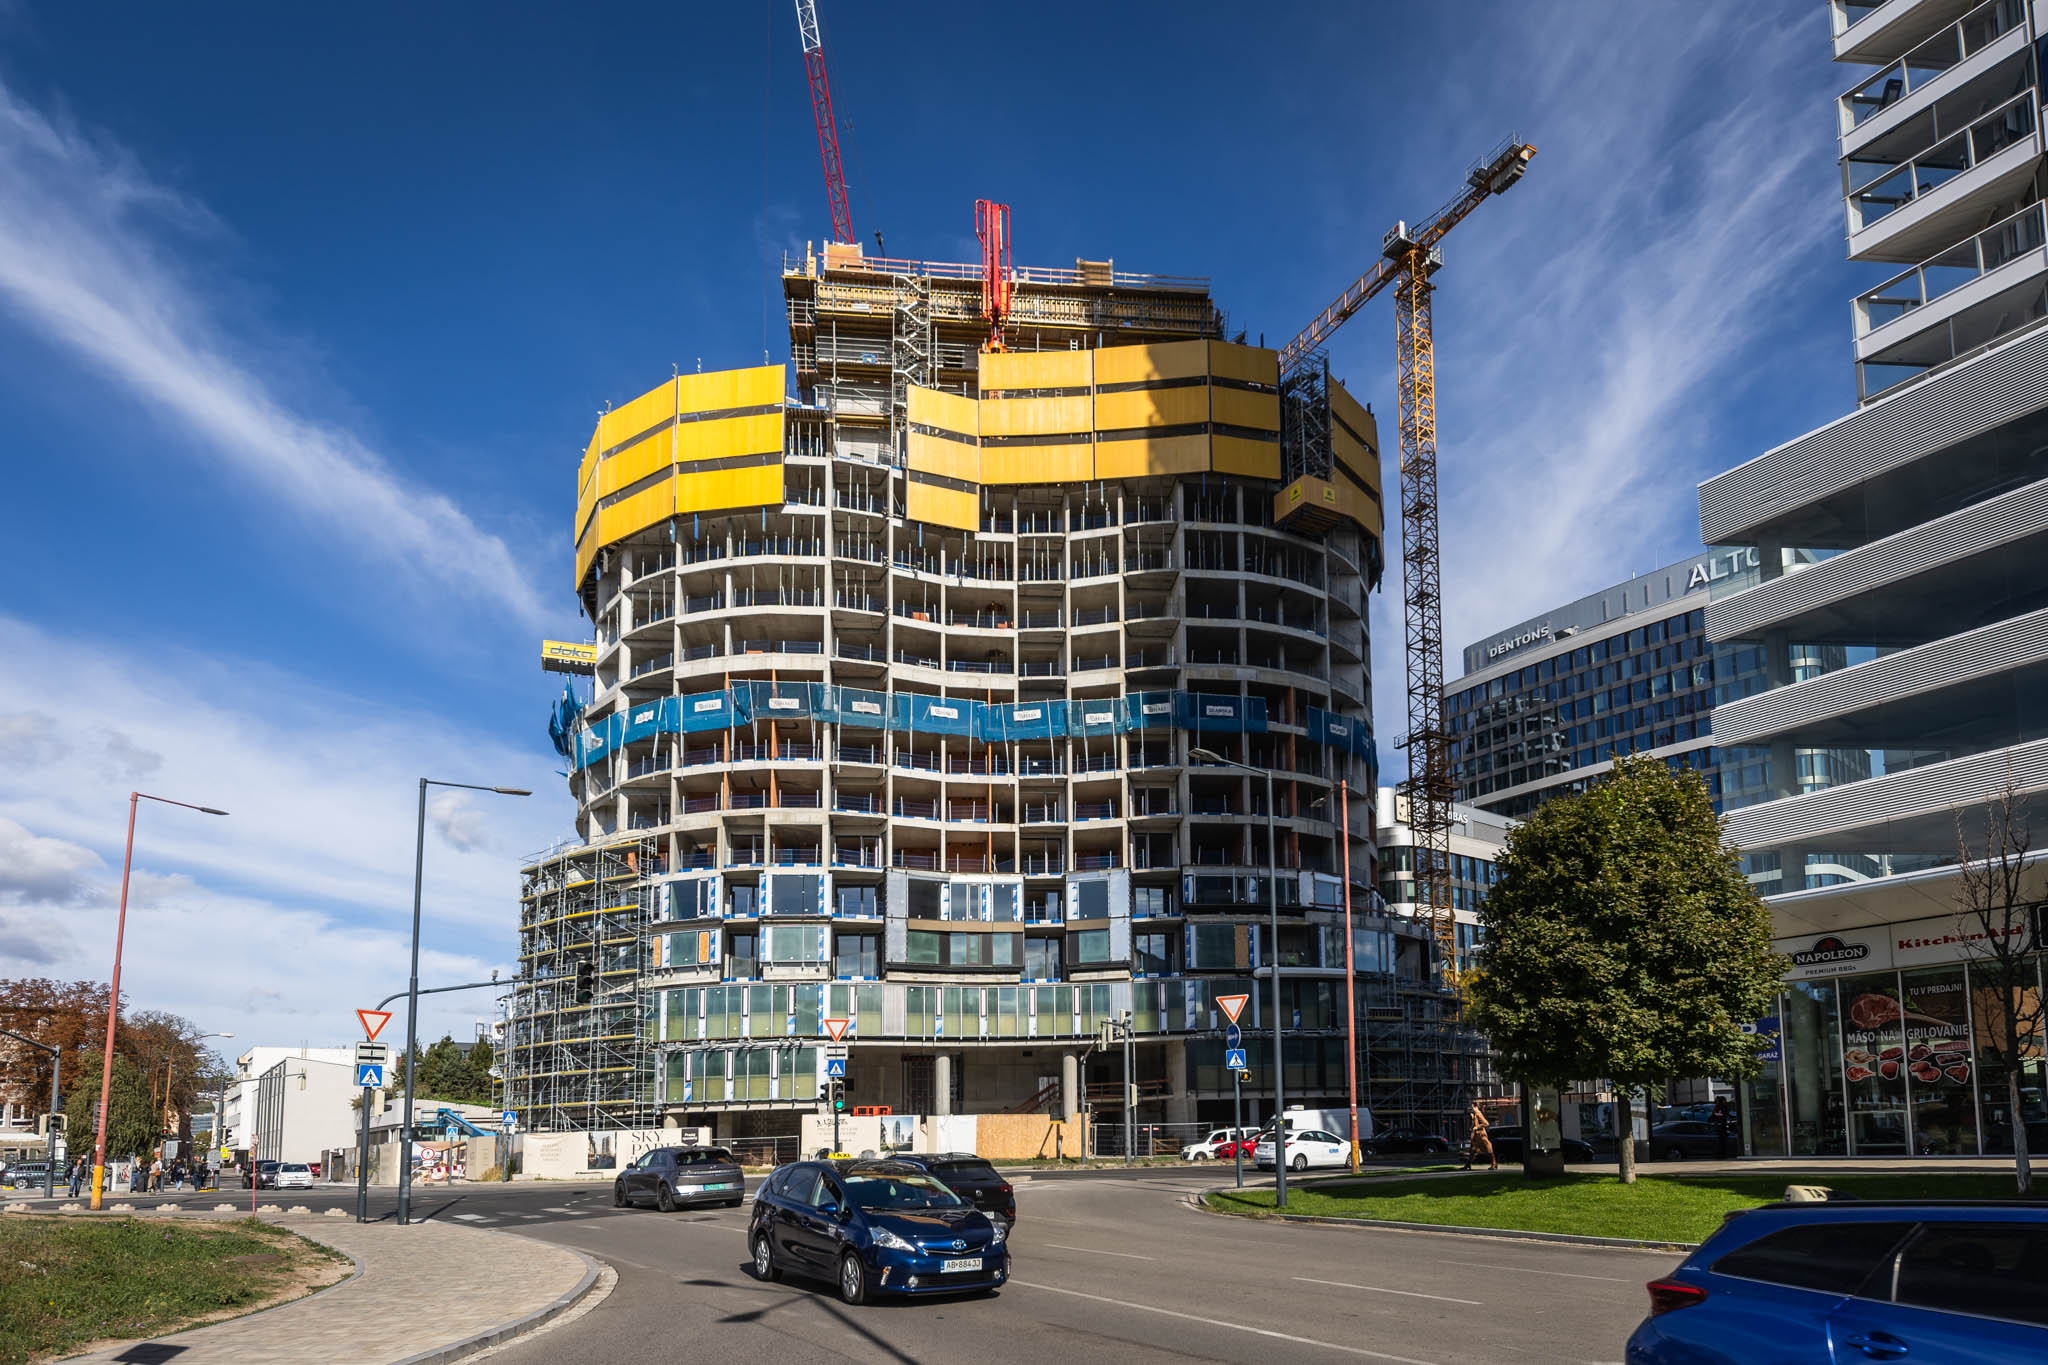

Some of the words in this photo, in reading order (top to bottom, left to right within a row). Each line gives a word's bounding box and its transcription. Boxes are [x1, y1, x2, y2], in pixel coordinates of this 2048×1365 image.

[1489, 626, 1549, 658] DENTONS
[550, 645, 592, 659] doka
[1898, 925, 2023, 950] KitchenAid
[1796, 947, 1864, 964] NAPOLEON
[1805, 967, 1837, 976] PREMIUM
[1909, 988, 1919, 996] TU
[1920, 987, 1926, 995] V
[1927, 984, 1962, 994] PREDAJNI
[1847, 1030, 1876, 1044] MÄSO
[1881, 1030, 1896, 1041] NA
[1906, 1023, 1969, 1040] GRILOVANIE
[632, 1131, 664, 1143] SKY
